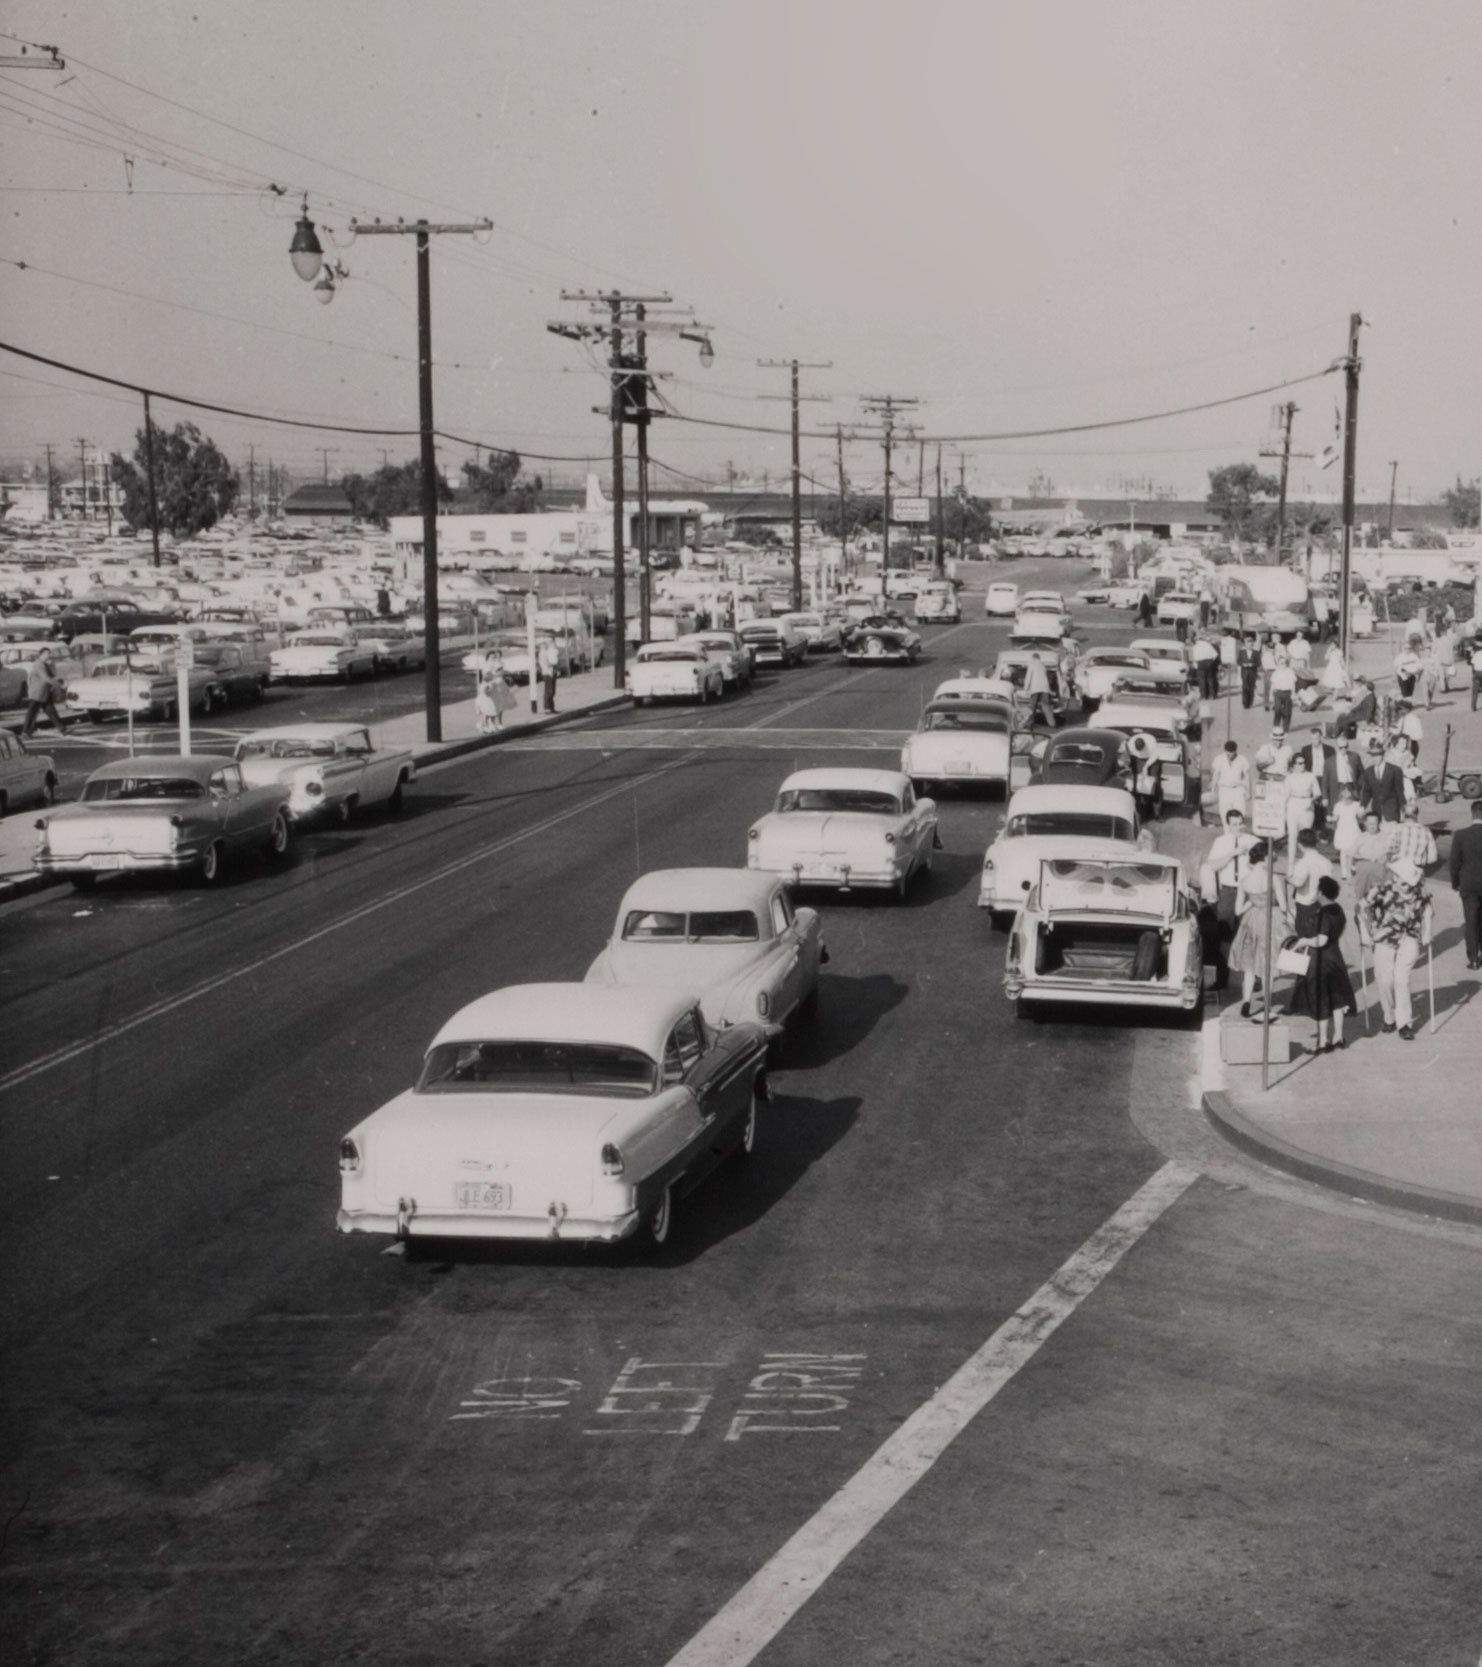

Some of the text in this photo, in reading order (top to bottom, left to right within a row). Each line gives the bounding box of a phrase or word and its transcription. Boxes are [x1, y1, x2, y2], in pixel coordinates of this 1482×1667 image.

[448, 1376, 582, 1420] NO
[582, 1356, 729, 1436] LEFT
[724, 1353, 868, 1441] TURN
